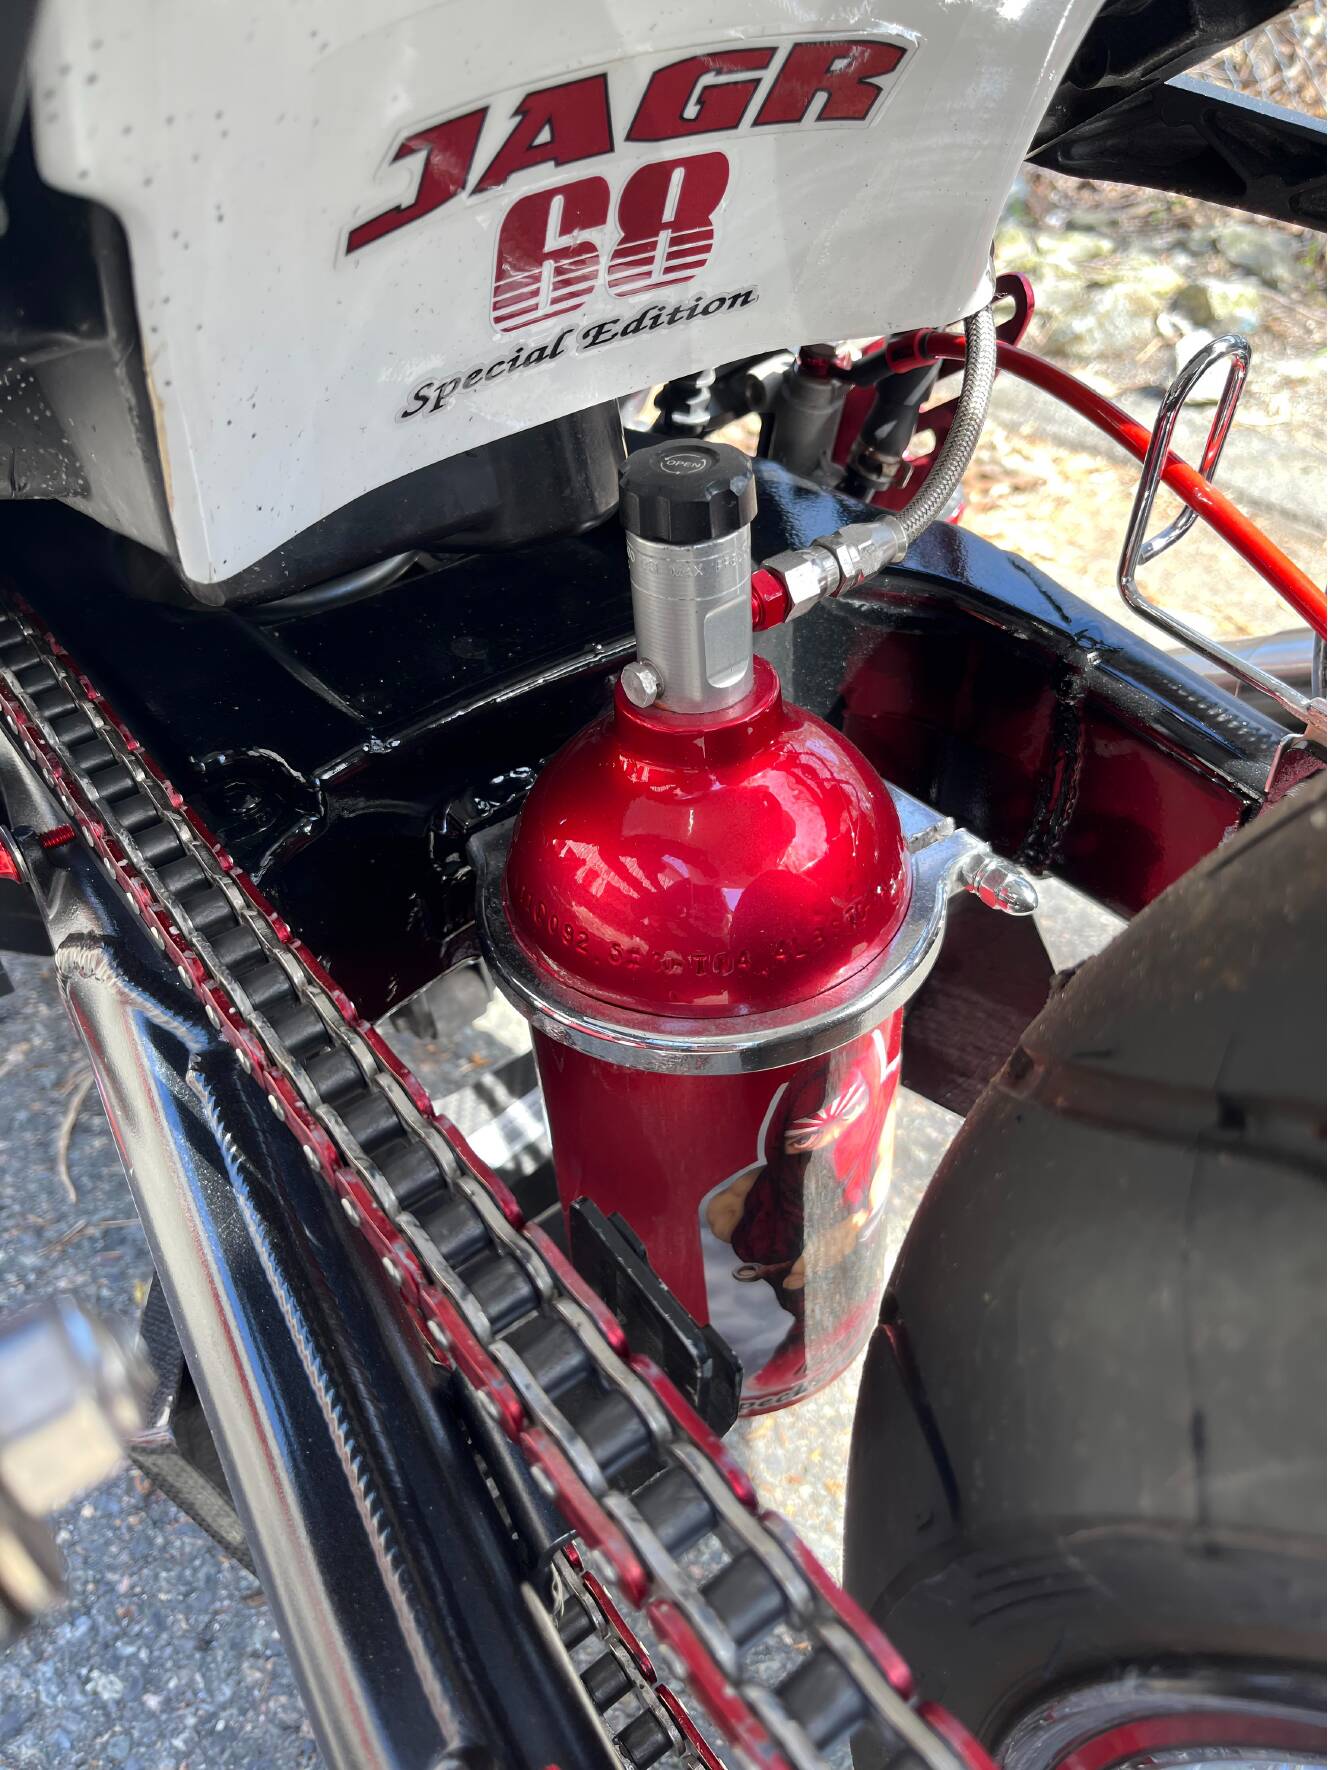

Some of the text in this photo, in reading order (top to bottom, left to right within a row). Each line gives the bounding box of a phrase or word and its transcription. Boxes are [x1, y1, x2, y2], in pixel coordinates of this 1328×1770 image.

[345, 39, 907, 254] JAGR
[492, 151, 730, 332] 68
[401, 289, 755, 419] Special Edition
[666, 459, 701, 468] OPEN
